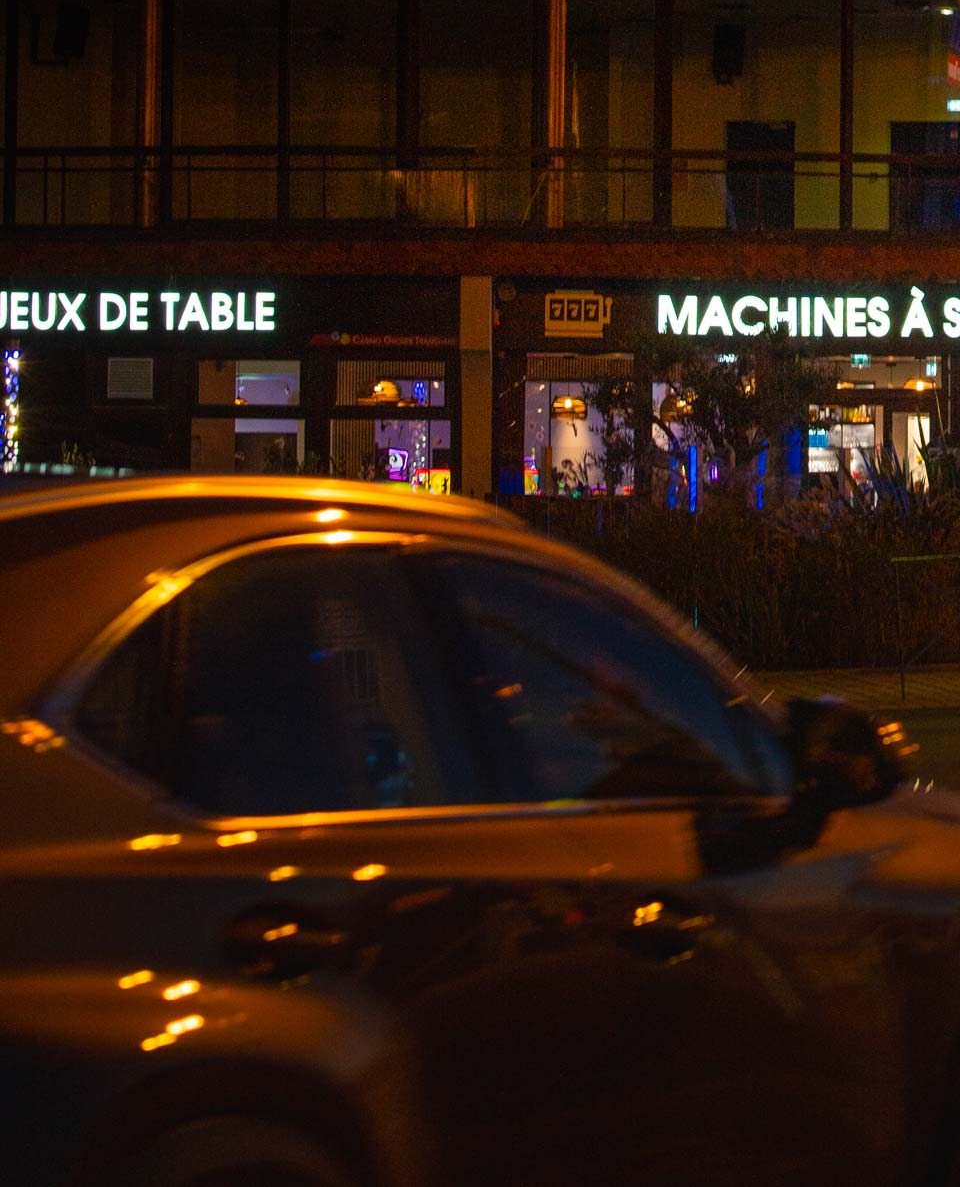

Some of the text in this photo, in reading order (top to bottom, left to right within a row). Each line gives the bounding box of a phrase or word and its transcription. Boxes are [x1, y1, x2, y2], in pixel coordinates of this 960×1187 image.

[0, 291, 275, 332] JEUX DE TABLE
[657, 294, 891, 338] MACHINES
[900, 285, 934, 338] À
